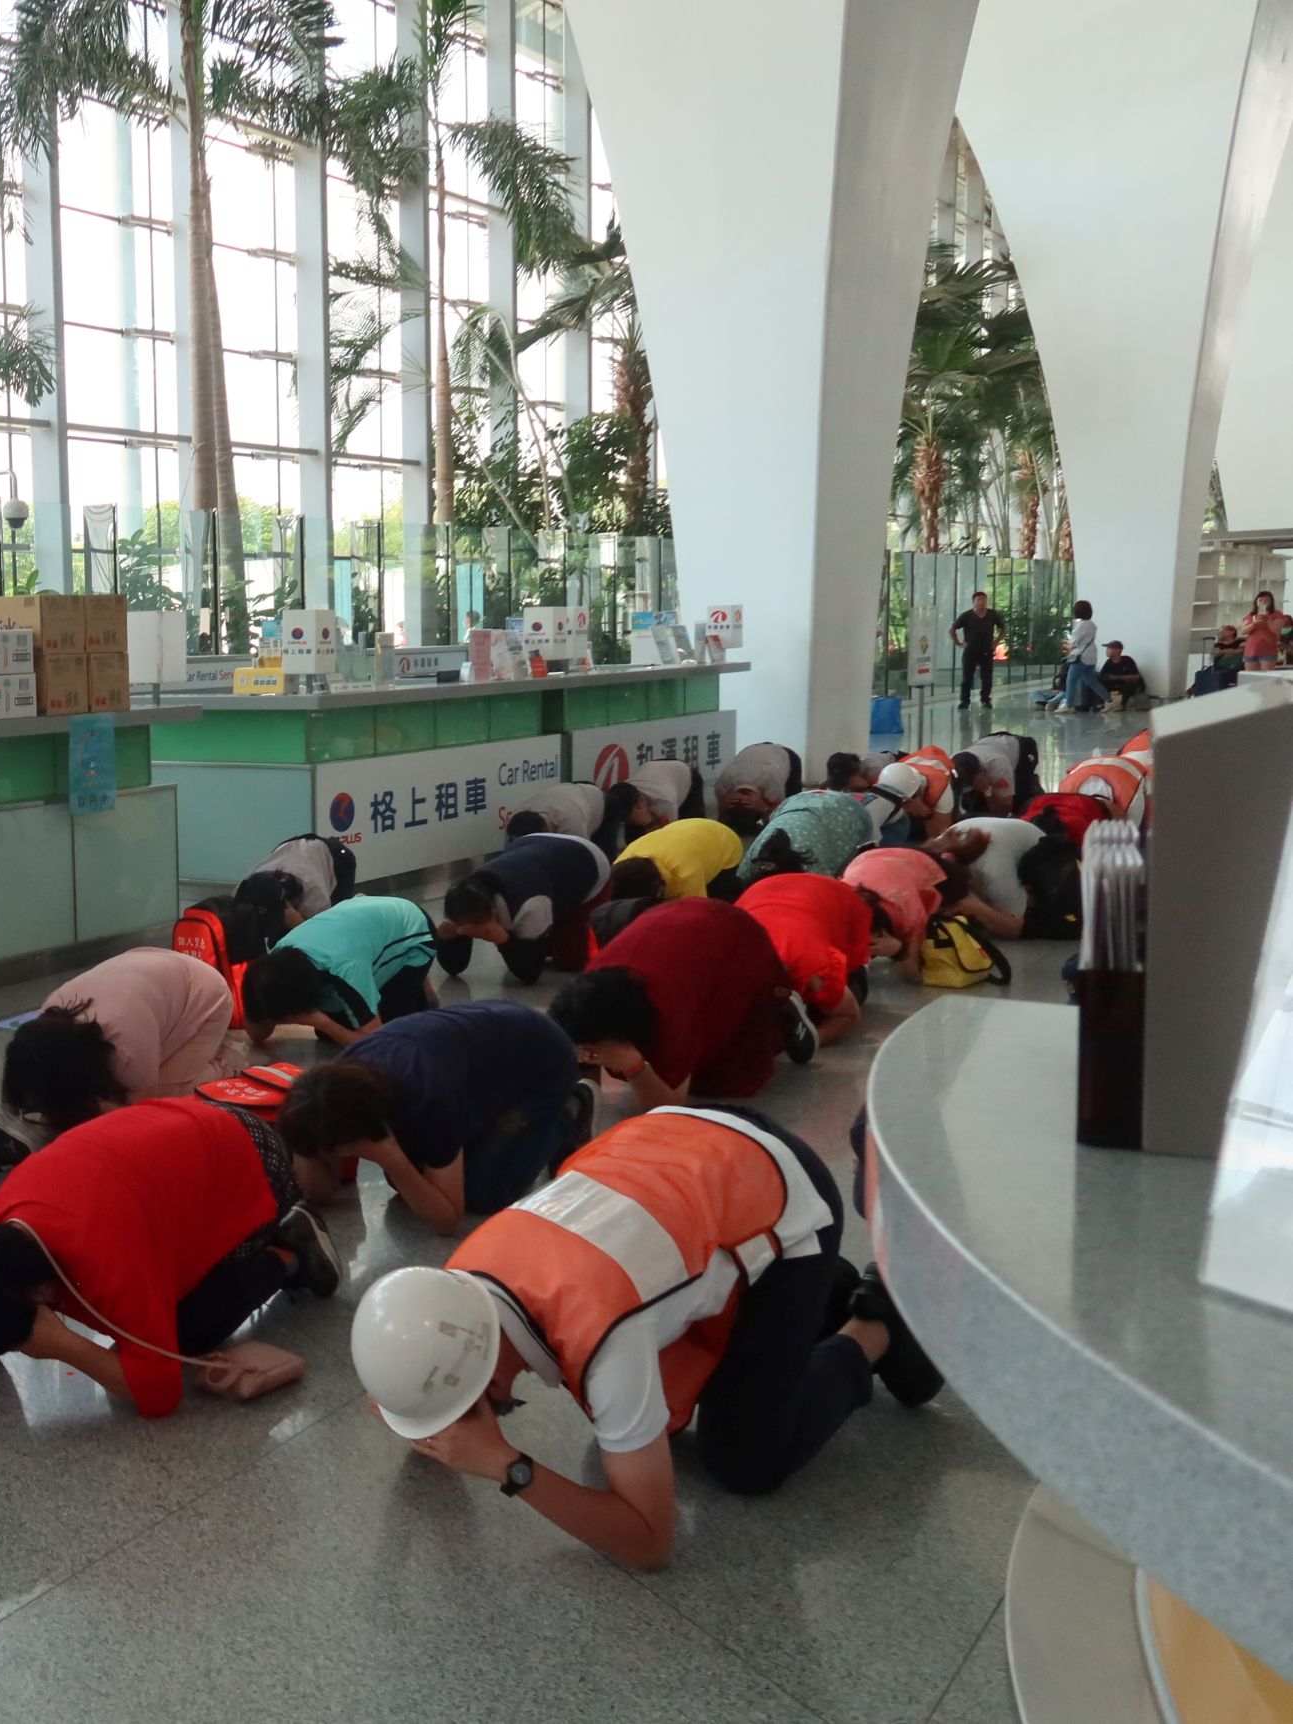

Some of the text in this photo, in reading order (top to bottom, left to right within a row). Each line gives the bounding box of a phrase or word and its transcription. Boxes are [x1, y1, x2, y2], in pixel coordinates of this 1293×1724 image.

[196, 670, 218, 681] Rental
[219, 669, 234, 680] Serv
[497, 753, 559, 786] Car Rental
[370, 776, 487, 834] 格上租車
